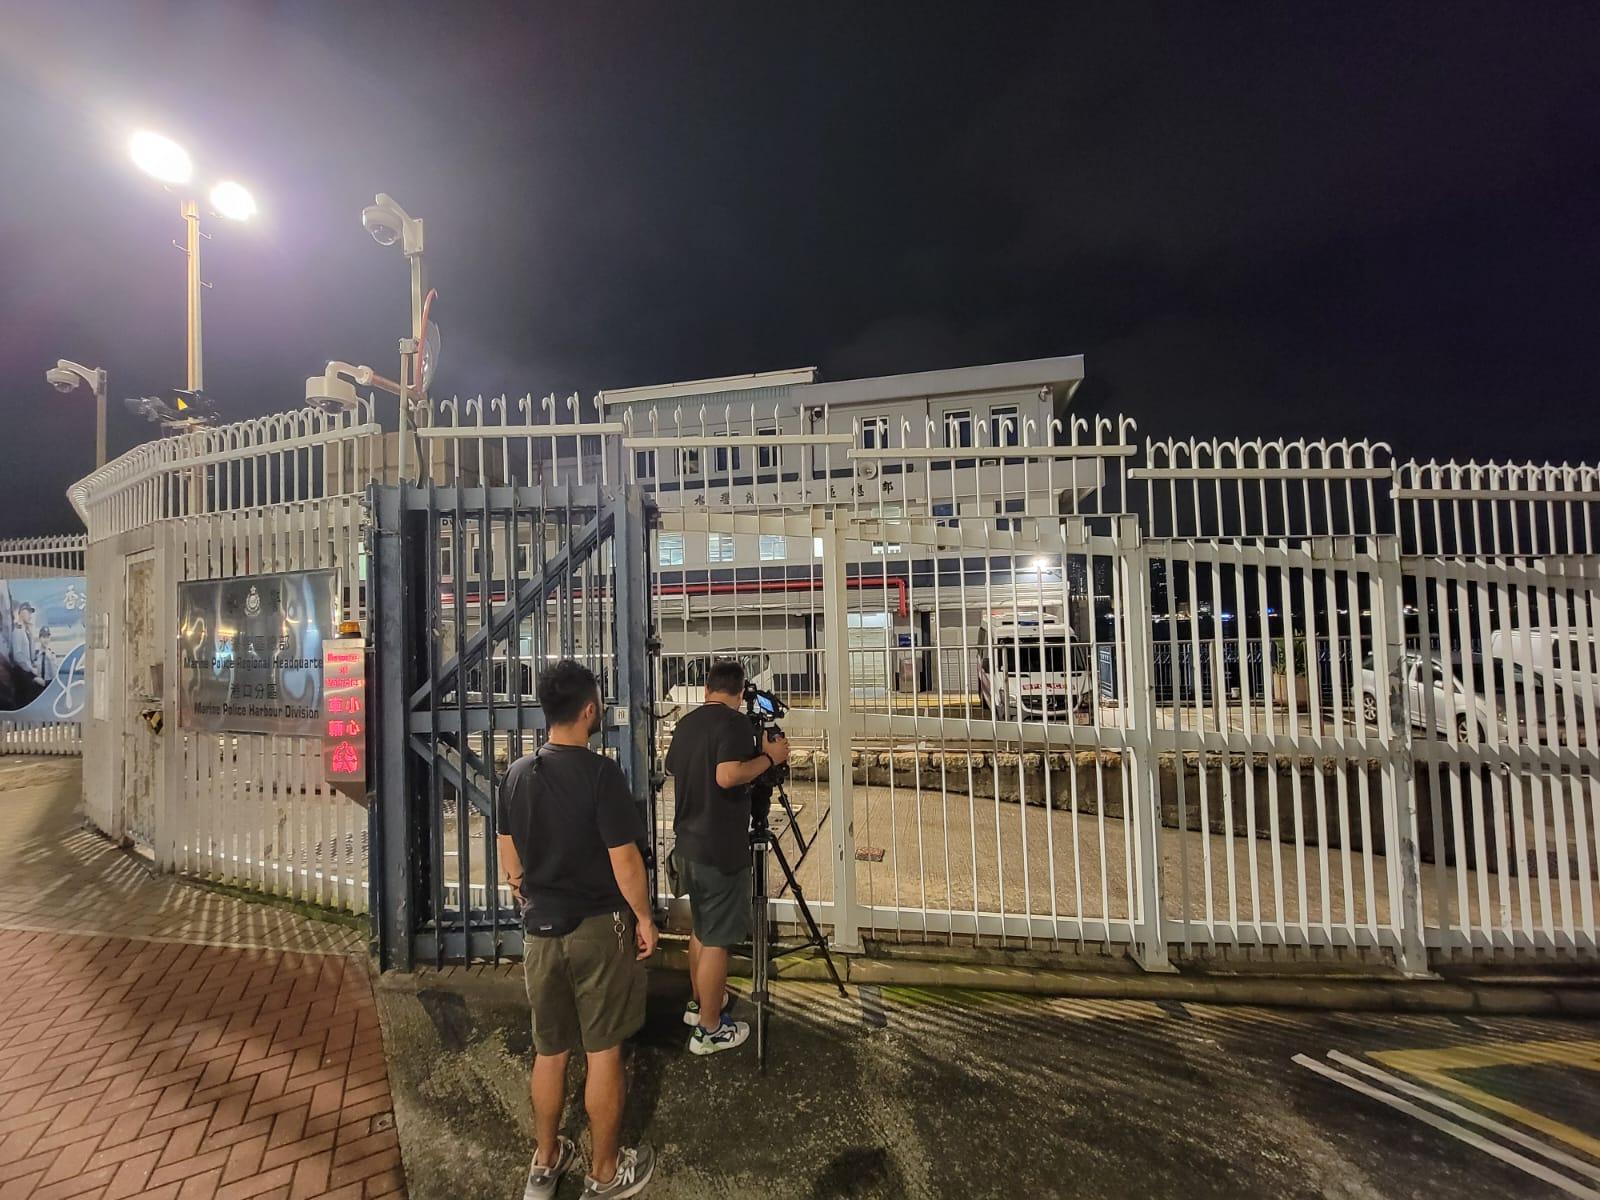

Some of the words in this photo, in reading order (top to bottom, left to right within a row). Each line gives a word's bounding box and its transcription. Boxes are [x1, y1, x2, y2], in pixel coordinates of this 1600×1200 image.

[184, 656, 208, 669] Marine
[212, 657, 234, 670] Police
[236, 656, 270, 672] Regional
[273, 655, 323, 673] Headquarte
[194, 702, 220, 715] Marine
[223, 703, 247, 716] Police
[249, 704, 282, 717] Harbour
[285, 705, 320, 719] Division
